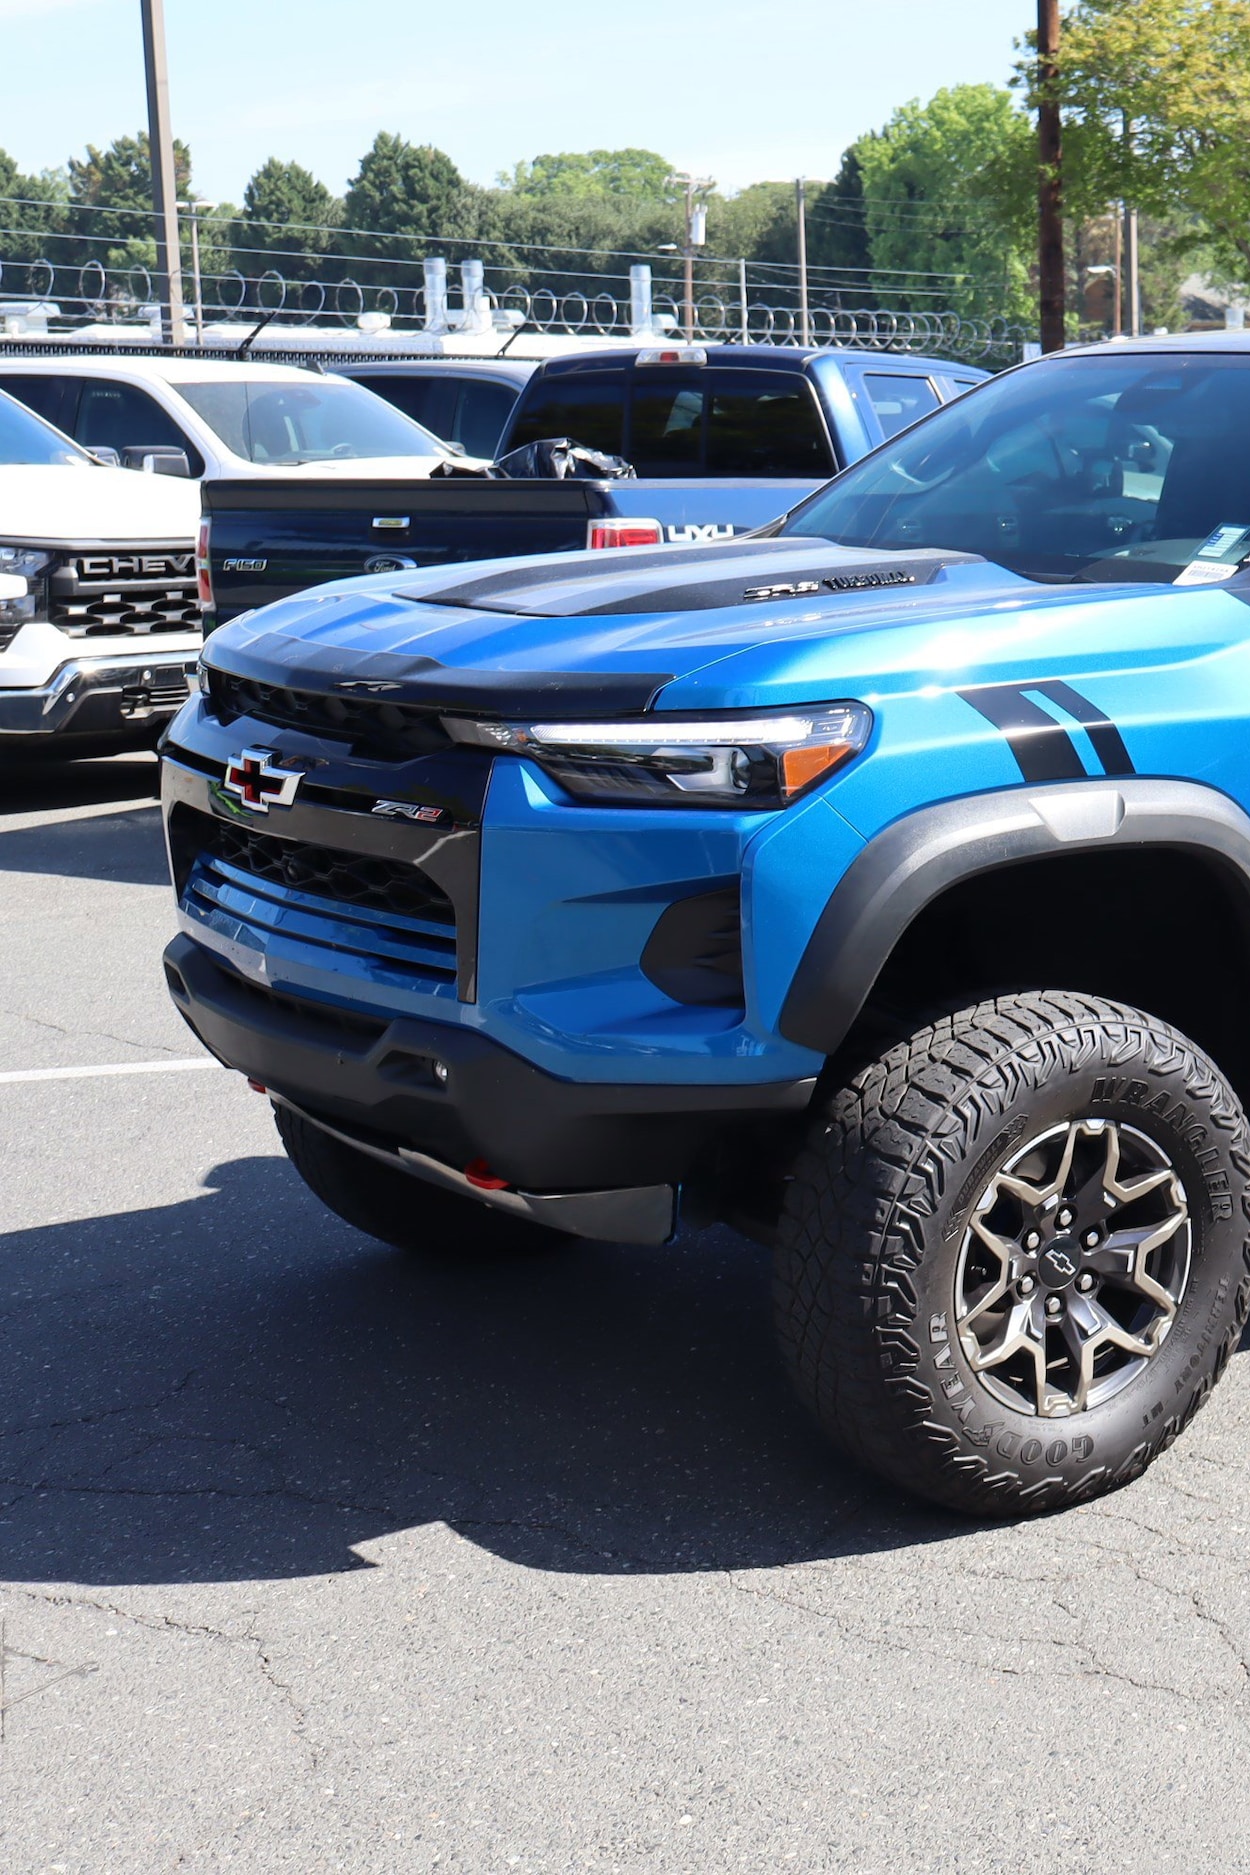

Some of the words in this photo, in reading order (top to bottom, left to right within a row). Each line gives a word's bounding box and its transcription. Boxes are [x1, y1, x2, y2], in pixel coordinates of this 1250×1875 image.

[371, 799, 444, 822] ZR2
[1091, 1077, 1234, 1222] WRANGLER
[928, 1311, 1095, 1468] GOODYEAR
